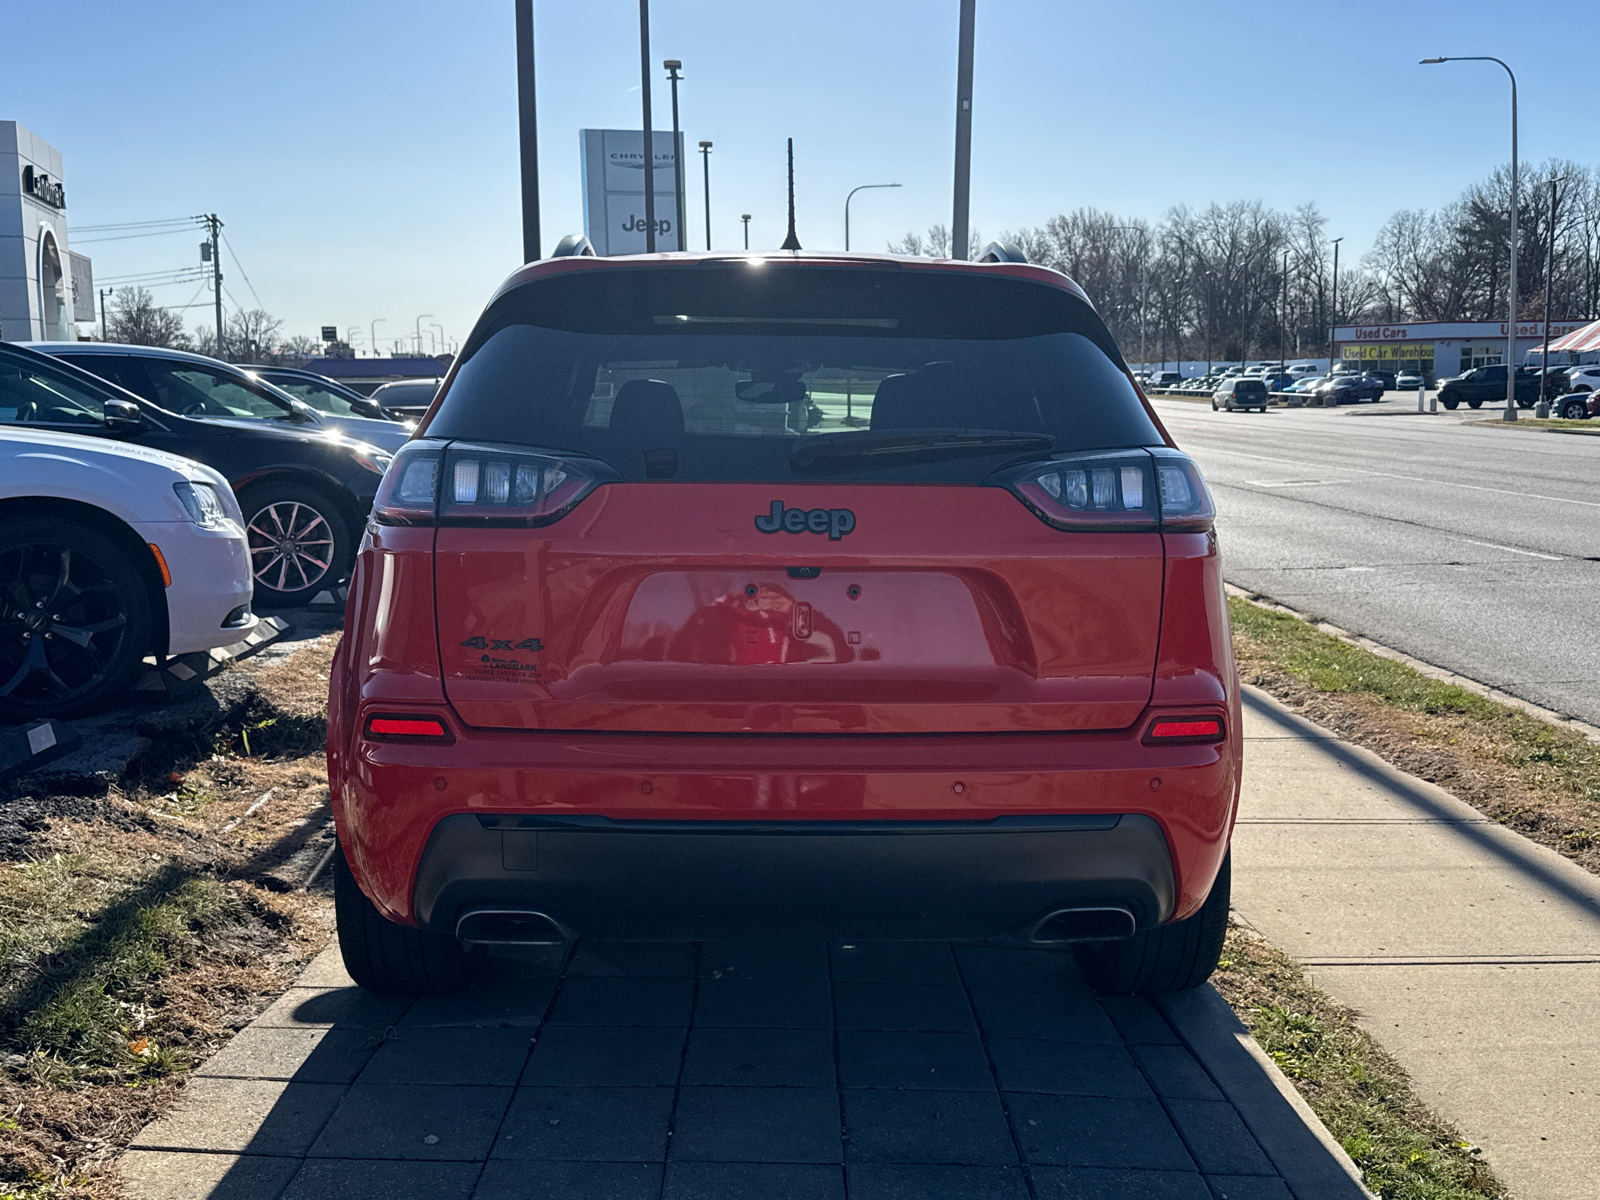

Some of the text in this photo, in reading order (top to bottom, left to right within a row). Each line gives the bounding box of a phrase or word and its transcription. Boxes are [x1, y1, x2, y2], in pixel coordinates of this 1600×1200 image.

[1355, 327, 1407, 339] Used Cars
[1343, 347, 1367, 359] Used
[1368, 347, 1387, 358] Car
[754, 500, 856, 541] Jeep
[460, 636, 544, 652] 4x4
[489, 662, 537, 672] LANDMARK
